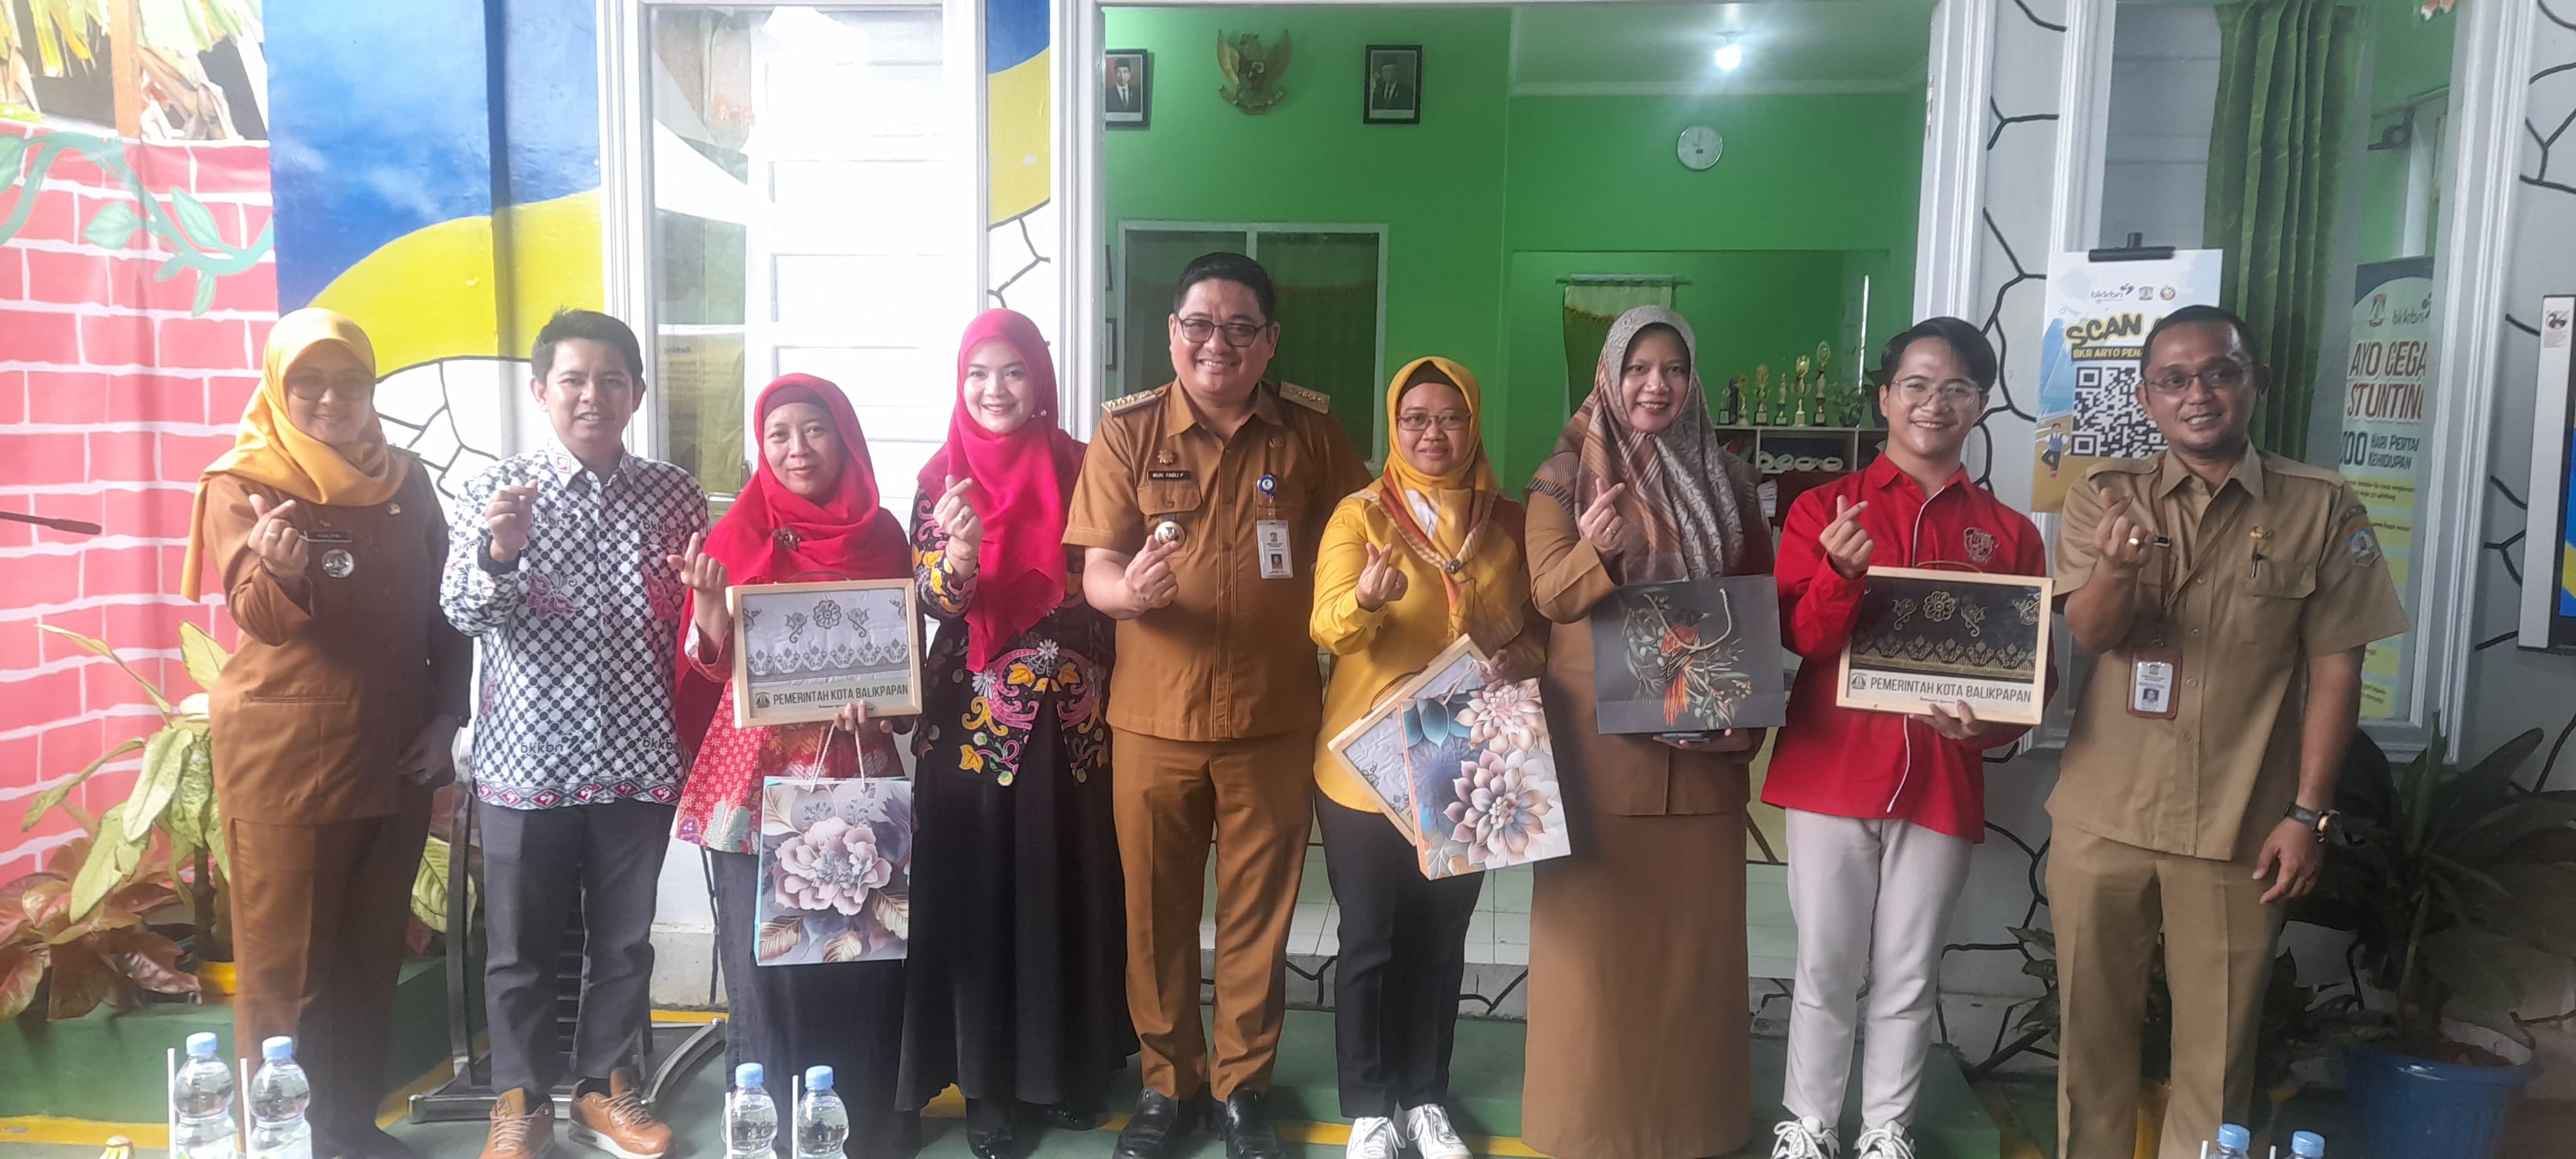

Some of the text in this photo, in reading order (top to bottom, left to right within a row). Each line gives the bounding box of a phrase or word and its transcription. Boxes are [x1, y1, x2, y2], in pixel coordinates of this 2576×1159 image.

[2065, 313, 2143, 348] SCAN
[2349, 340, 2428, 377] AYO CEGA
[2340, 430, 2368, 466] 00
[532, 513, 565, 526] kkbn
[773, 684, 909, 706] PEMERINTAH KOTA BALIKPAPAN
[1870, 677, 2032, 703] PEMERINTAH KOTA BALIKPAPAN
[520, 741, 564, 753] bkkbn
